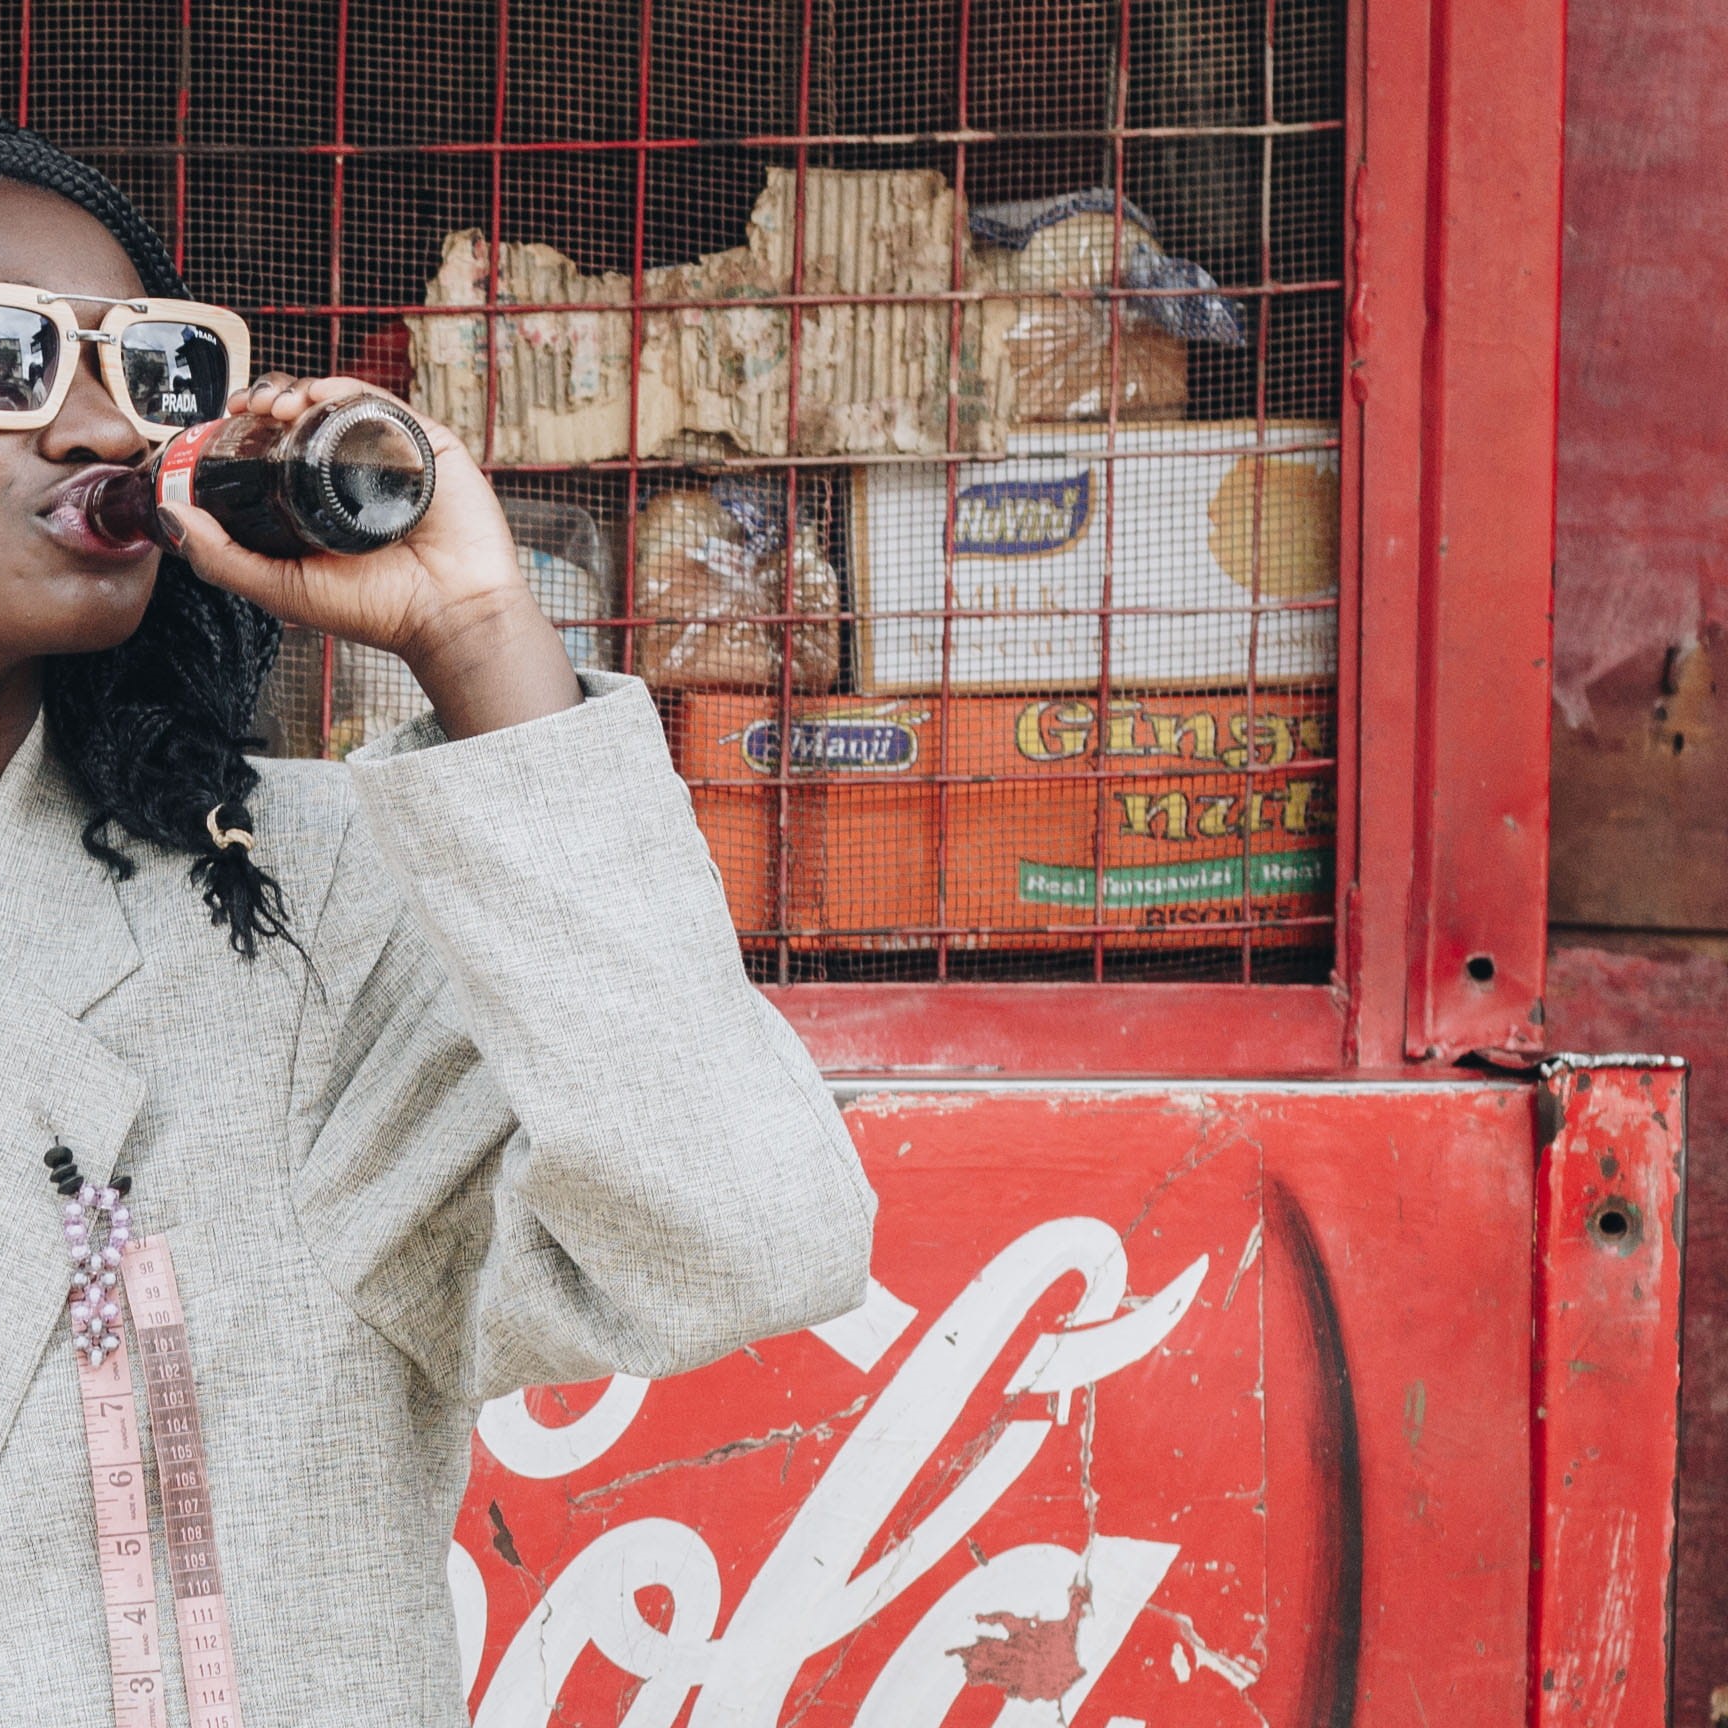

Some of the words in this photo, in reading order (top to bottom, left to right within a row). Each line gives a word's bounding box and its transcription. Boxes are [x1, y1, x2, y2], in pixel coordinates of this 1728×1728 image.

[194, 329, 217, 345] PRADA
[162, 393, 198, 413] PRADA
[139, 1262, 155, 1275] 98
[145, 1287, 161, 1299] 99
[148, 1310, 170, 1324] 100
[153, 1338, 175, 1352] 101
[158, 1365, 181, 1379] 102
[162, 1392, 185, 1405] 103
[99, 1401, 124, 1418] 7
[166, 1418, 189, 1432] 104
[170, 1445, 192, 1459] 105
[109, 1470, 133, 1487] 6
[175, 1472, 197, 1486] 106
[177, 1499, 200, 1514] 107
[180, 1527, 203, 1541] 108
[117, 1539, 142, 1556] 5
[183, 1554, 206, 1568] 109
[187, 1581, 211, 1595] 110
[123, 1607, 146, 1626] 4
[192, 1609, 214, 1622] 111
[195, 1636, 217, 1649] 112
[199, 1663, 221, 1676] 113
[130, 1676, 154, 1695] 3
[202, 1690, 225, 1704] 114
